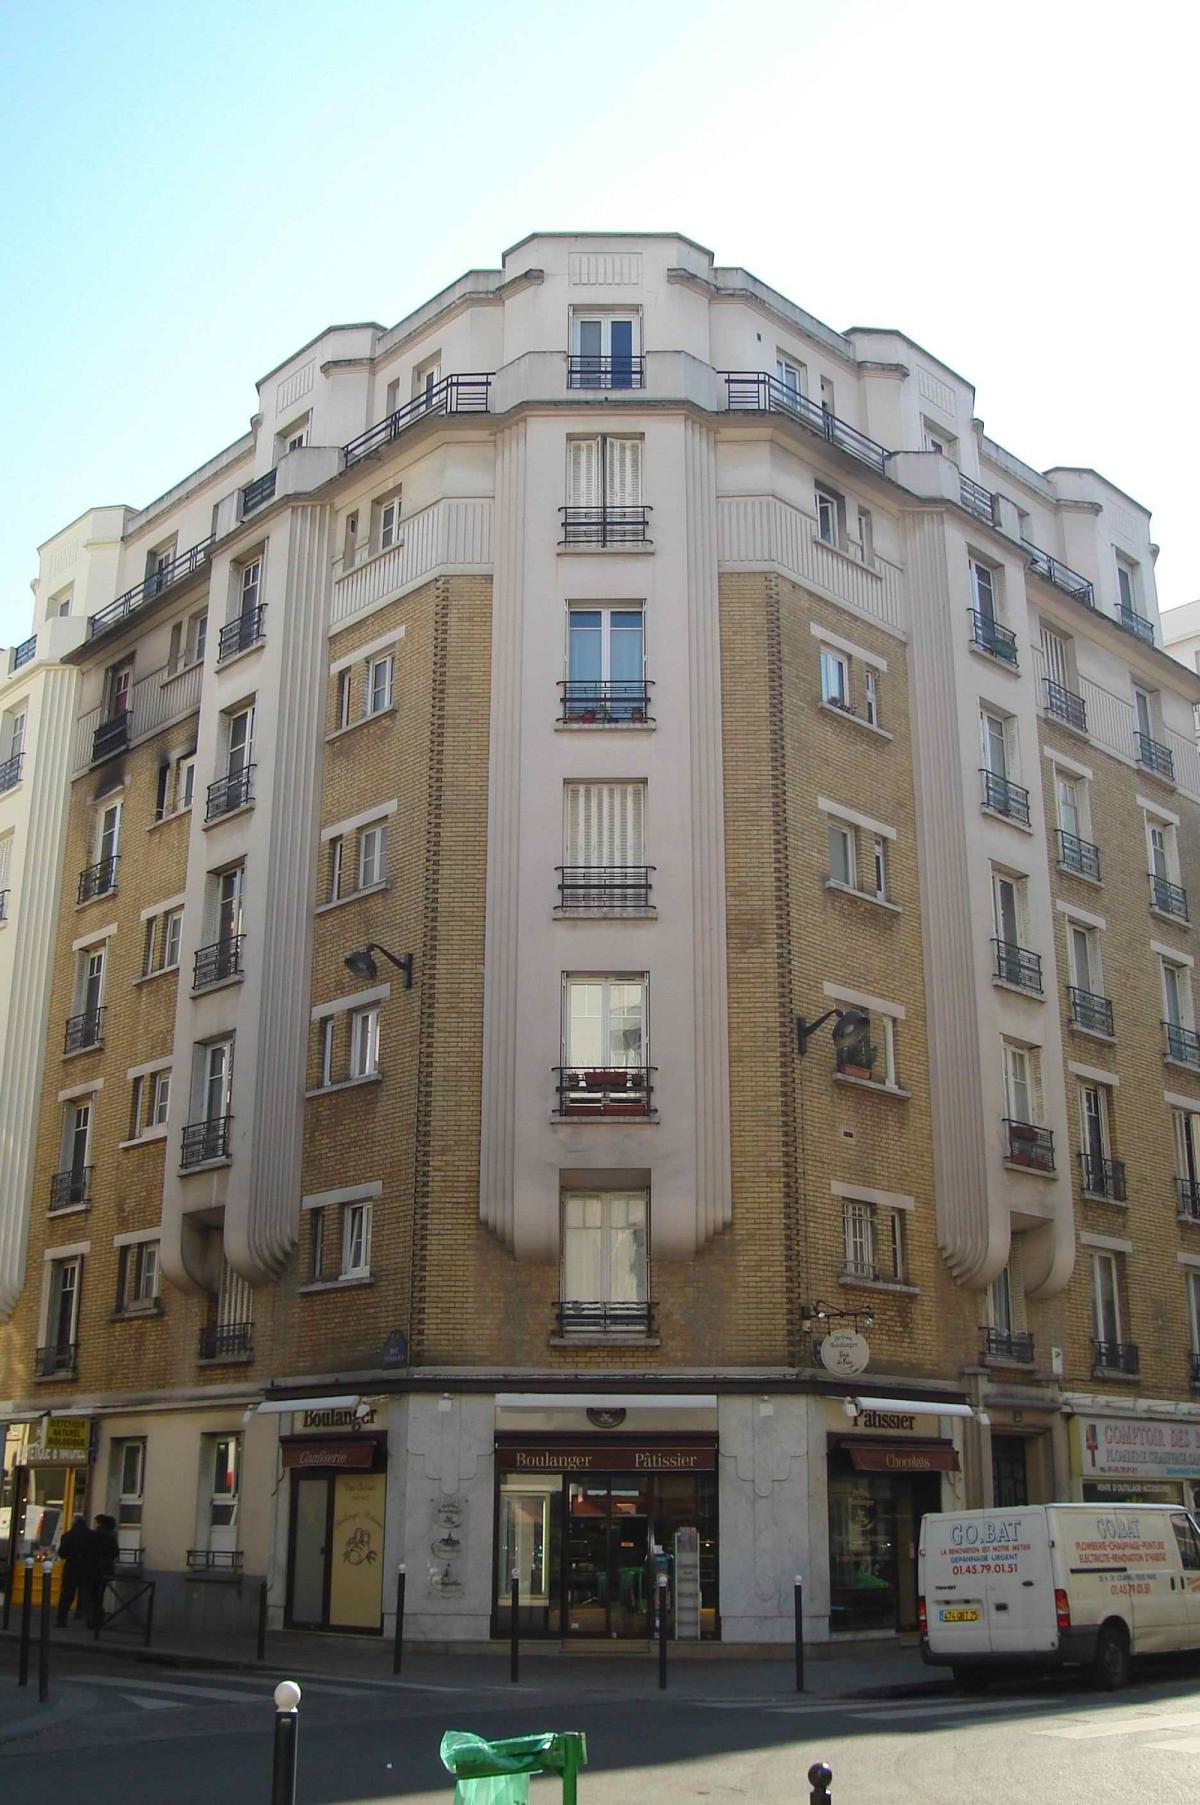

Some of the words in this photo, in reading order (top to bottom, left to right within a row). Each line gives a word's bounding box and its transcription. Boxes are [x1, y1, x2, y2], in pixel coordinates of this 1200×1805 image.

[1104, 1423, 1166, 1447] COMPTOIR
[299, 1450, 348, 1465] Confiserie
[516, 1453, 592, 1469] Boulanger
[634, 1452, 697, 1468] Pâtissier
[886, 1453, 931, 1468] Chocolats
[951, 1519, 1022, 1546] GO.BAT
[950, 1554, 988, 1563] DEPANNAGE
[991, 1552, 1018, 1561] URGENT
[952, 1563, 1018, 1576] 01.45.79.01.51
